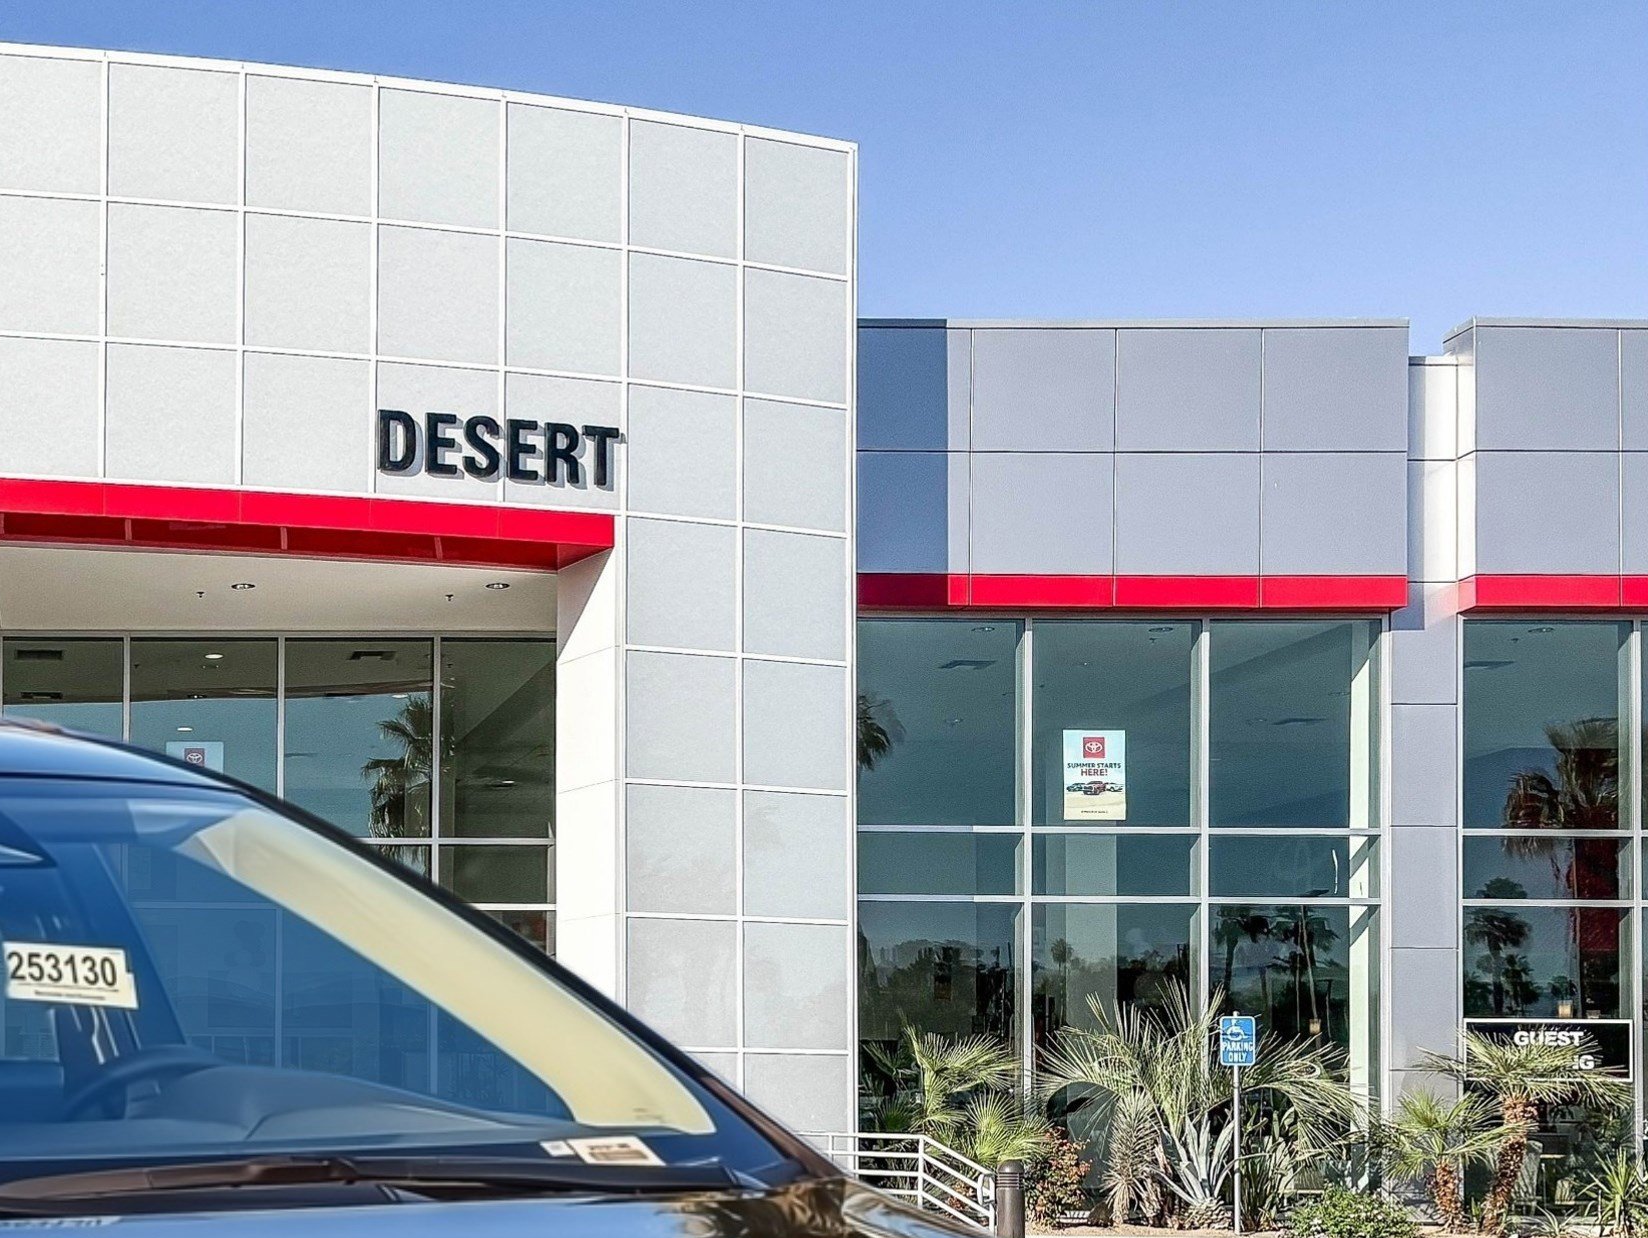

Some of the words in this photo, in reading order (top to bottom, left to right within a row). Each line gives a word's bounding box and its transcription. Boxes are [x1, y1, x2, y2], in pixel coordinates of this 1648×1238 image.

[377, 409, 621, 487] DESERT
[1081, 768, 1108, 777] HERE!
[7, 951, 118, 987] 253130
[1513, 1030, 1585, 1047] GUEST
[1222, 1041, 1254, 1051] PARKING
[1228, 1052, 1248, 1062] ONLY
